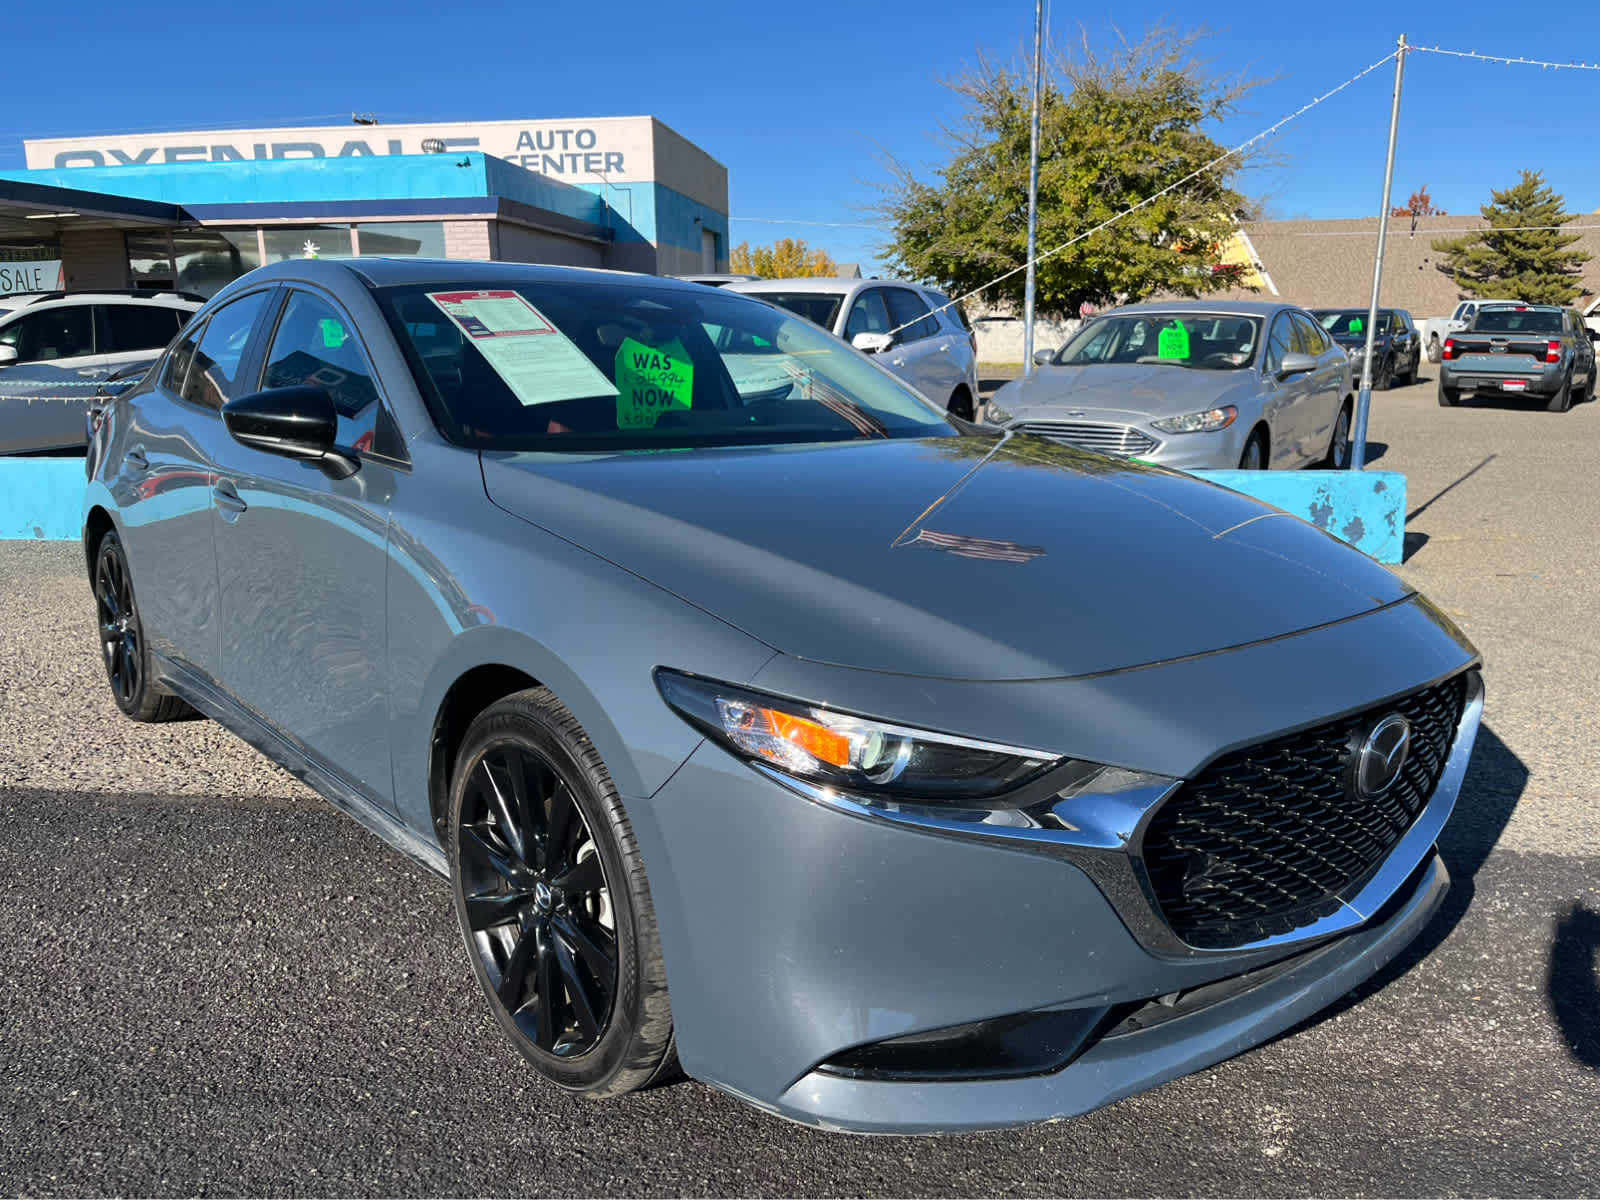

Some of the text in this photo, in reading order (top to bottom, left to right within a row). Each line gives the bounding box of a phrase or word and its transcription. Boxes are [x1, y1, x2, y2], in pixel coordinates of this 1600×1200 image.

[516, 129, 597, 151] AUTO
[0, 267, 43, 292] SALE
[633, 352, 672, 370] WAS
[633, 388, 674, 407] NOW
